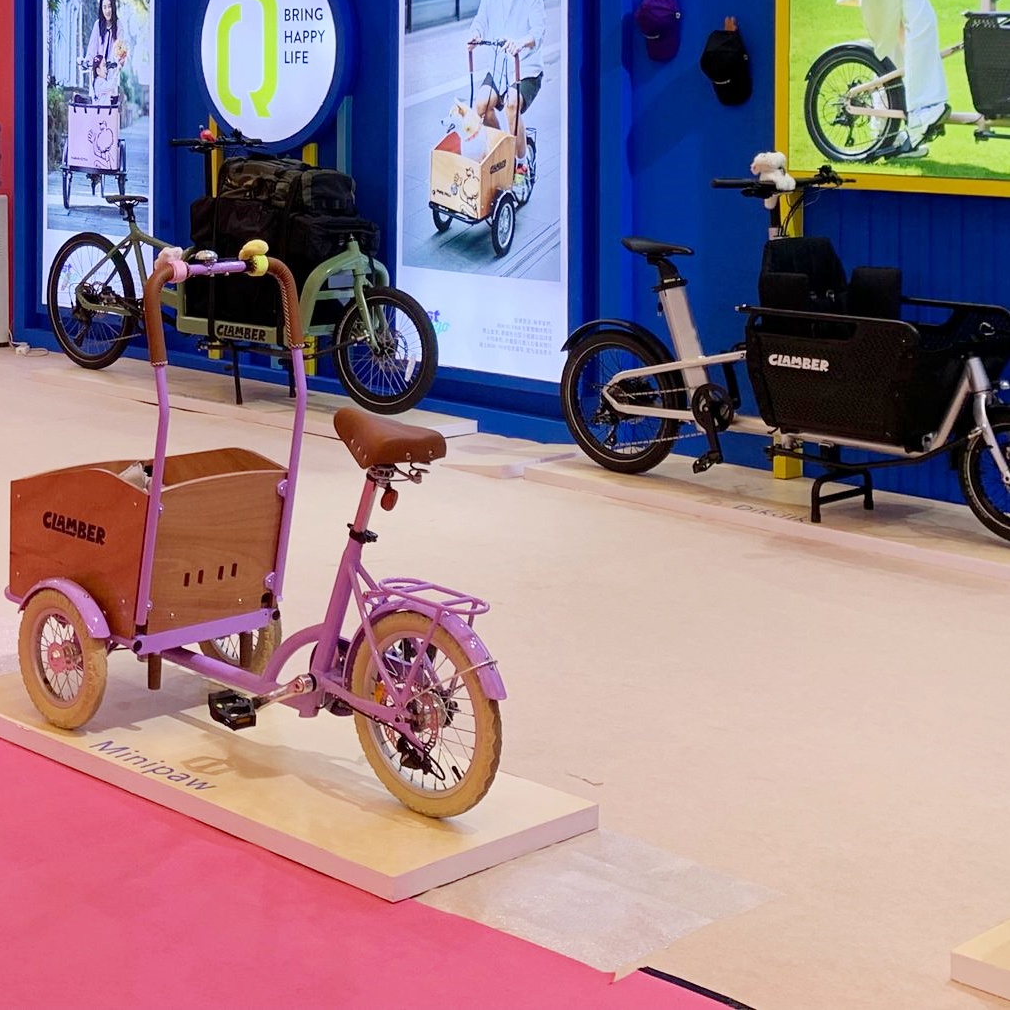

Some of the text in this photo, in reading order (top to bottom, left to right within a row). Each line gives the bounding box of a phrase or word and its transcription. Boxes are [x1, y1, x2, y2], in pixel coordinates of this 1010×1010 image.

[284, 7, 324, 22] BRING
[284, 29, 326, 44] HAPPY
[284, 50, 309, 64] LIFE
[216, 324, 266, 342] CLAMBER
[768, 353, 830, 372] CLAMBER
[42, 511, 107, 546] CLAMBER
[88, 740, 218, 791] Minipaw
